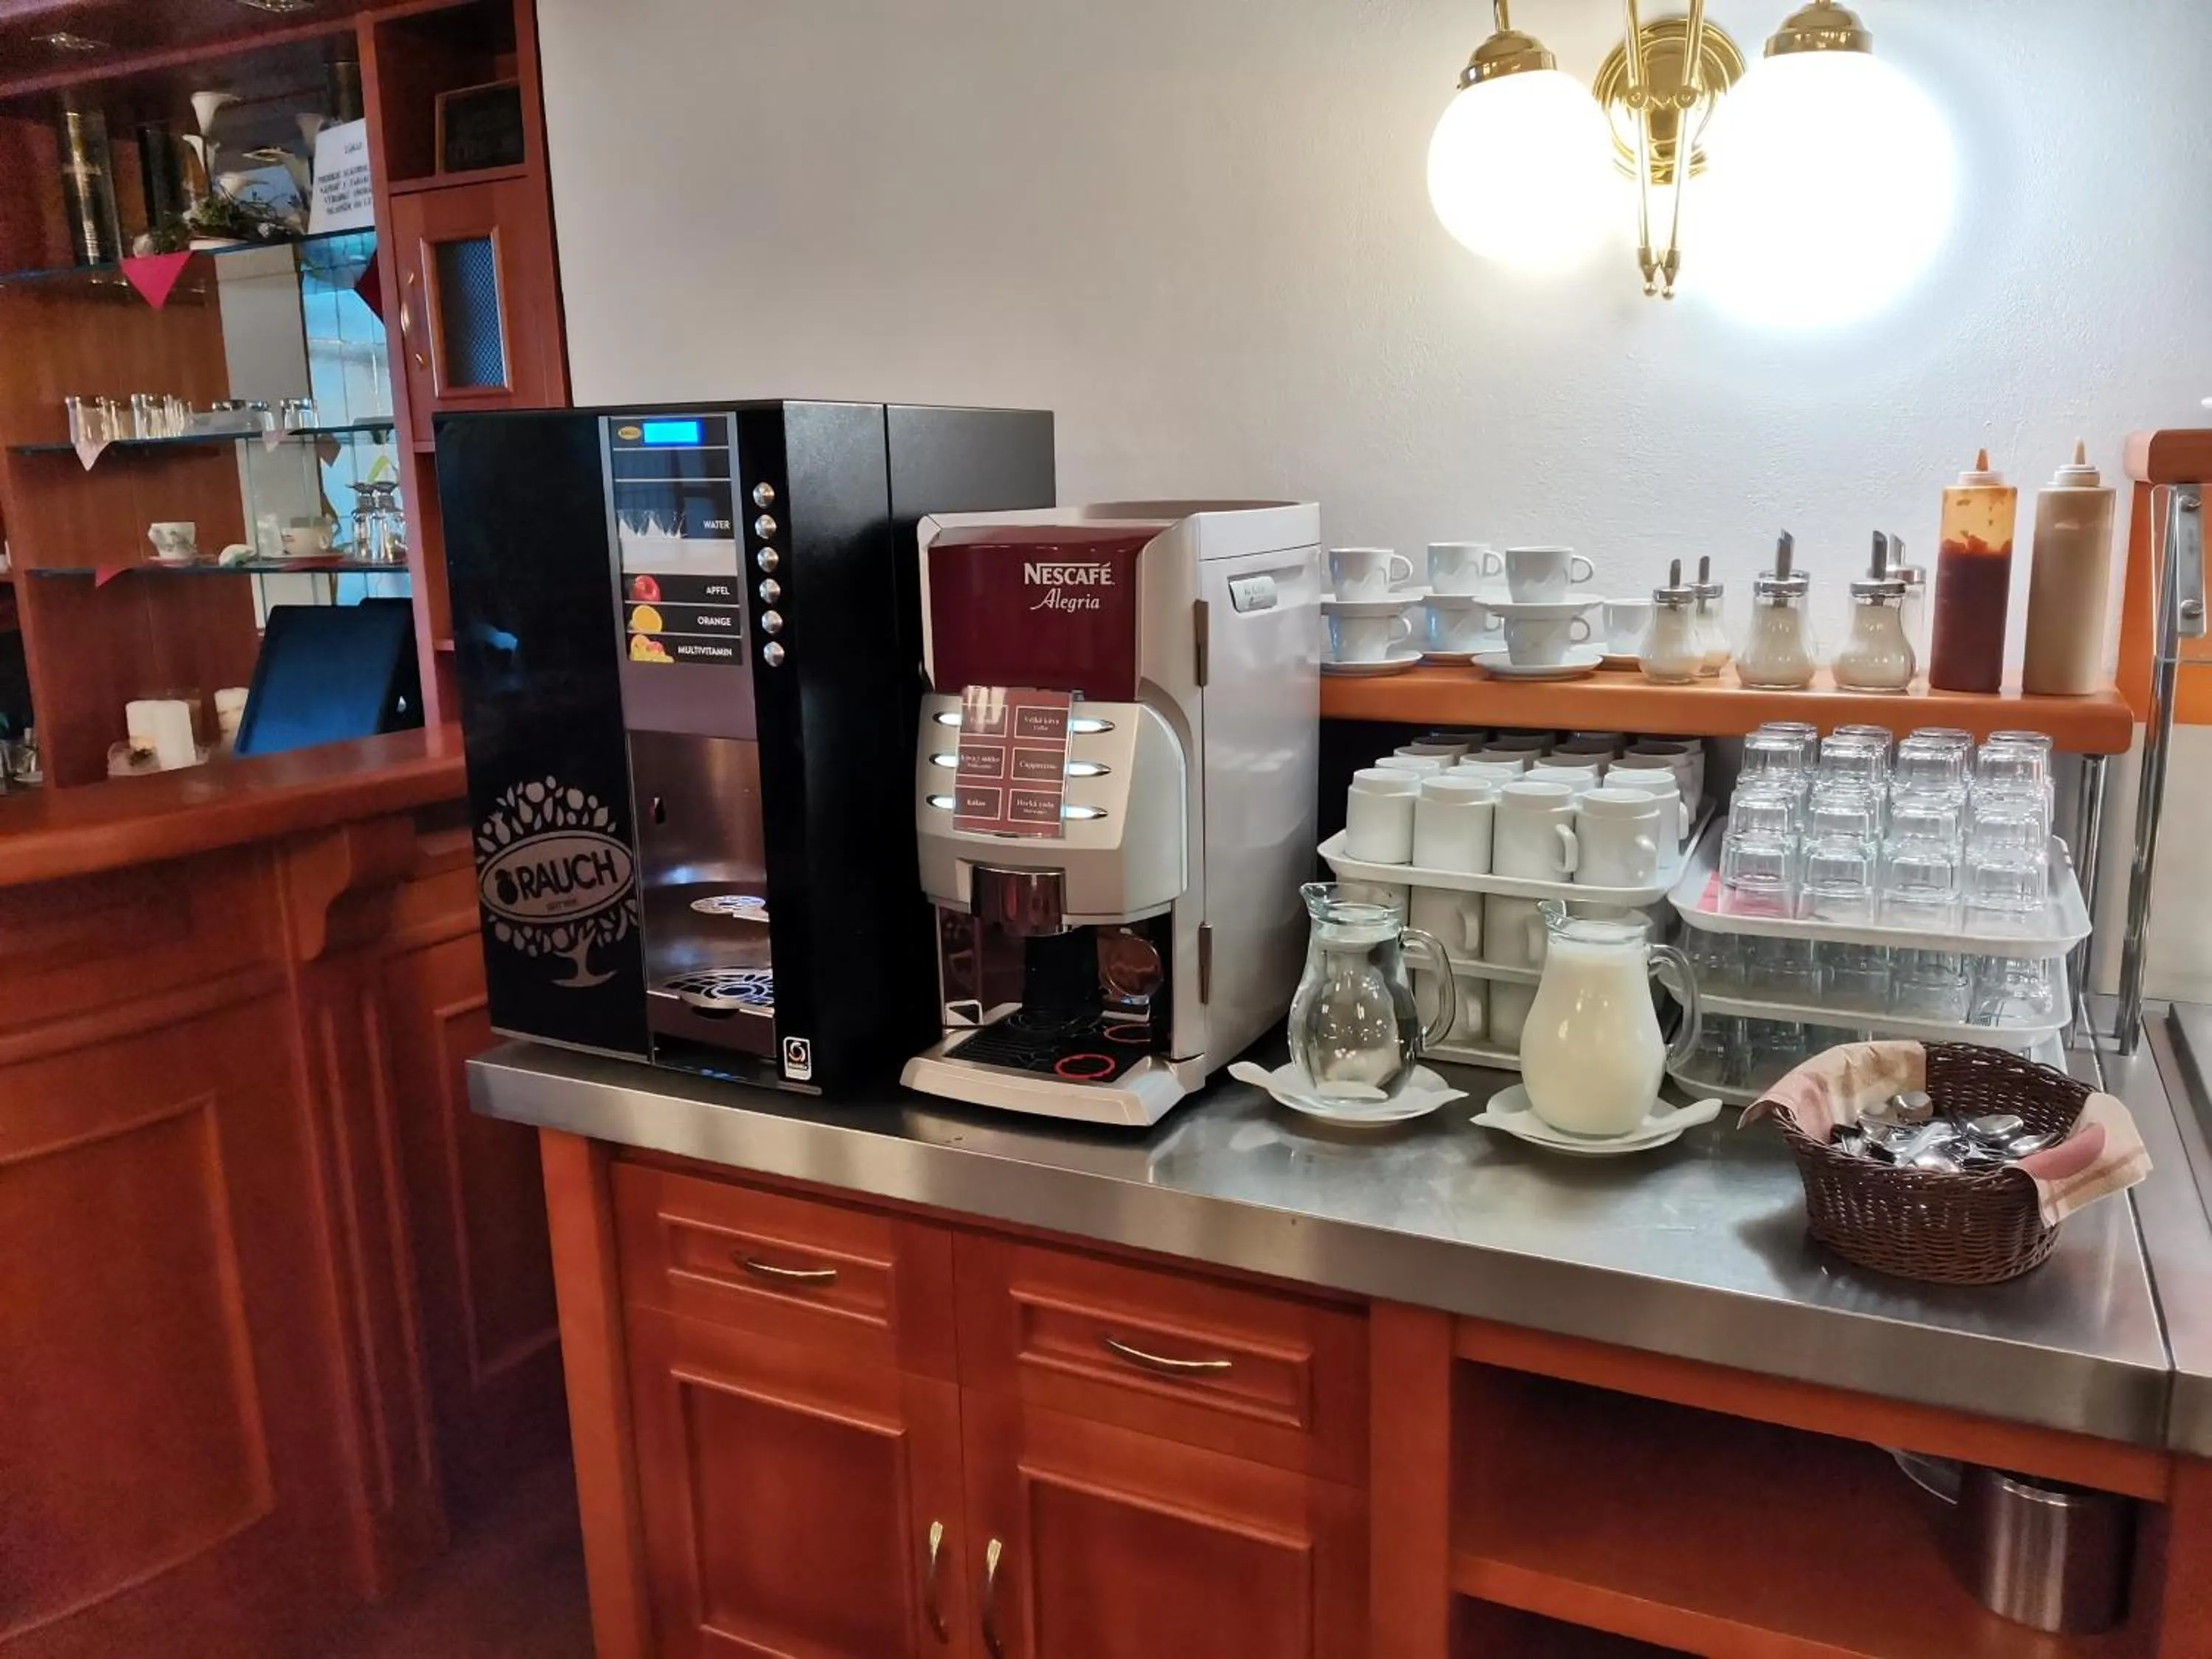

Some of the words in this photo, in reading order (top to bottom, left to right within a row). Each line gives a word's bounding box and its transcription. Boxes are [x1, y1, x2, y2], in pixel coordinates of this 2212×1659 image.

[703, 520, 731, 531] WATER
[1023, 561, 1113, 585] NESCAFÉ
[706, 585, 731, 596] APFEL
[1030, 588, 1100, 613] Alegria
[697, 616, 732, 627] ORANGE
[678, 645, 733, 657] MULTIVITAMIN
[516, 849, 618, 900] RAUCH
